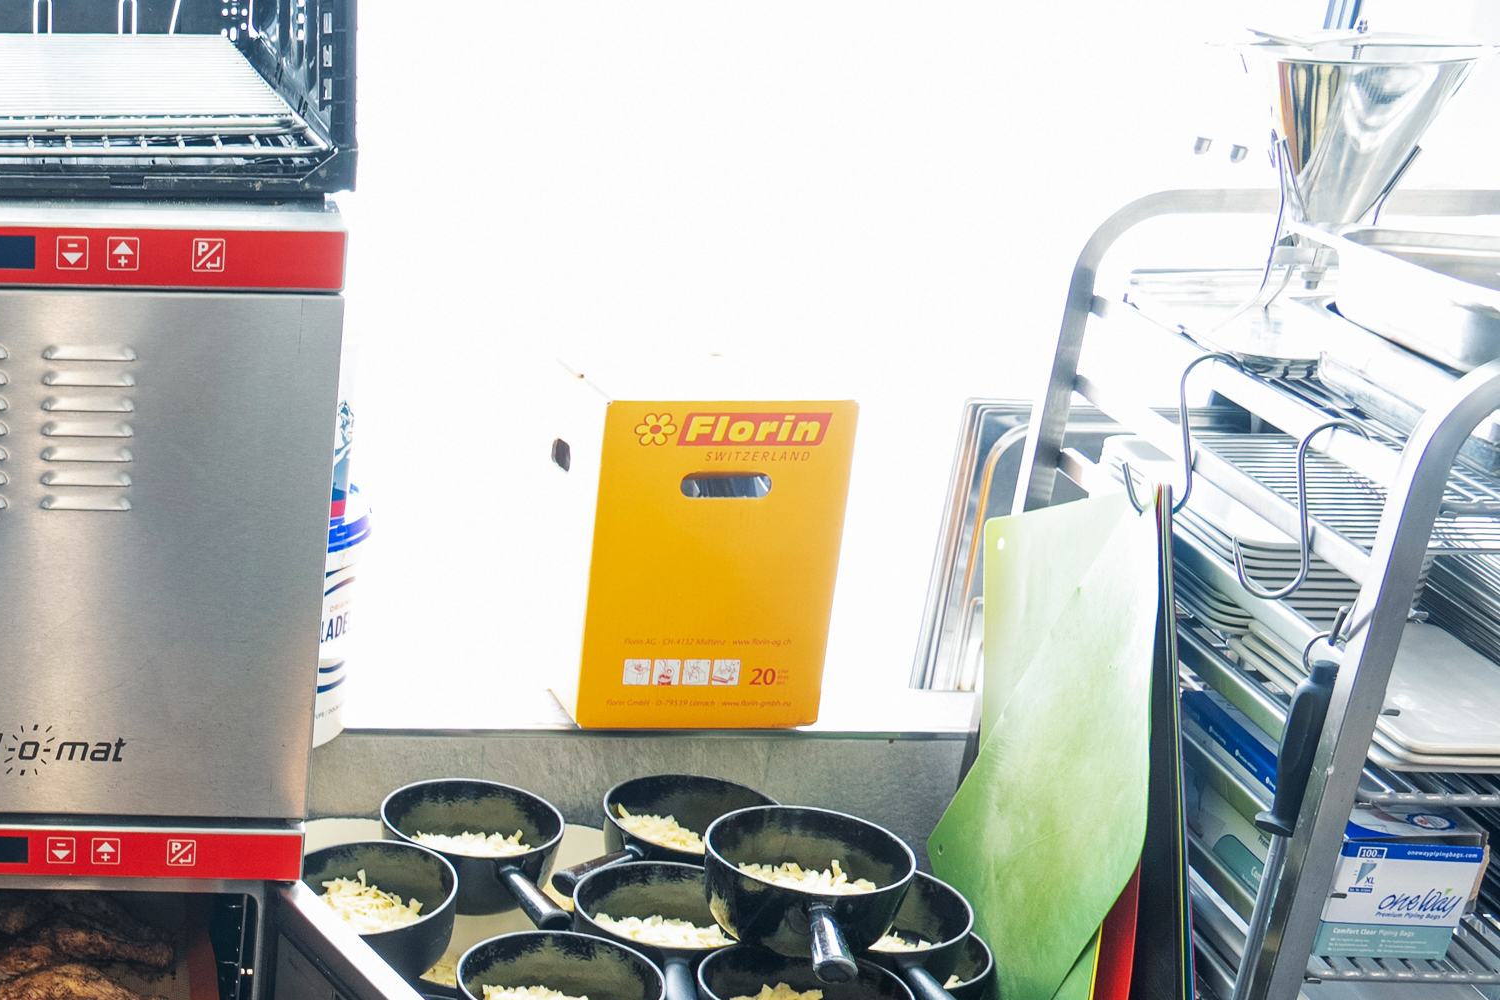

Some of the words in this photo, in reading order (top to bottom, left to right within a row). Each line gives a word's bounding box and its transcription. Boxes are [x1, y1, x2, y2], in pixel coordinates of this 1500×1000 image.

[685, 414, 822, 443] Florin
[704, 451, 812, 462] SWITZERLAND
[749, 668, 776, 686] 20
[1360, 849, 1378, 858] 100
[1407, 850, 1478, 860] onewaypipingbags.com
[1404, 912, 1424, 920] Piping
[1333, 927, 1359, 935] Comfort
[1360, 928, 1377, 936] Clear
[1378, 929, 1398, 938] Piping
[1399, 930, 1414, 938] Bags
